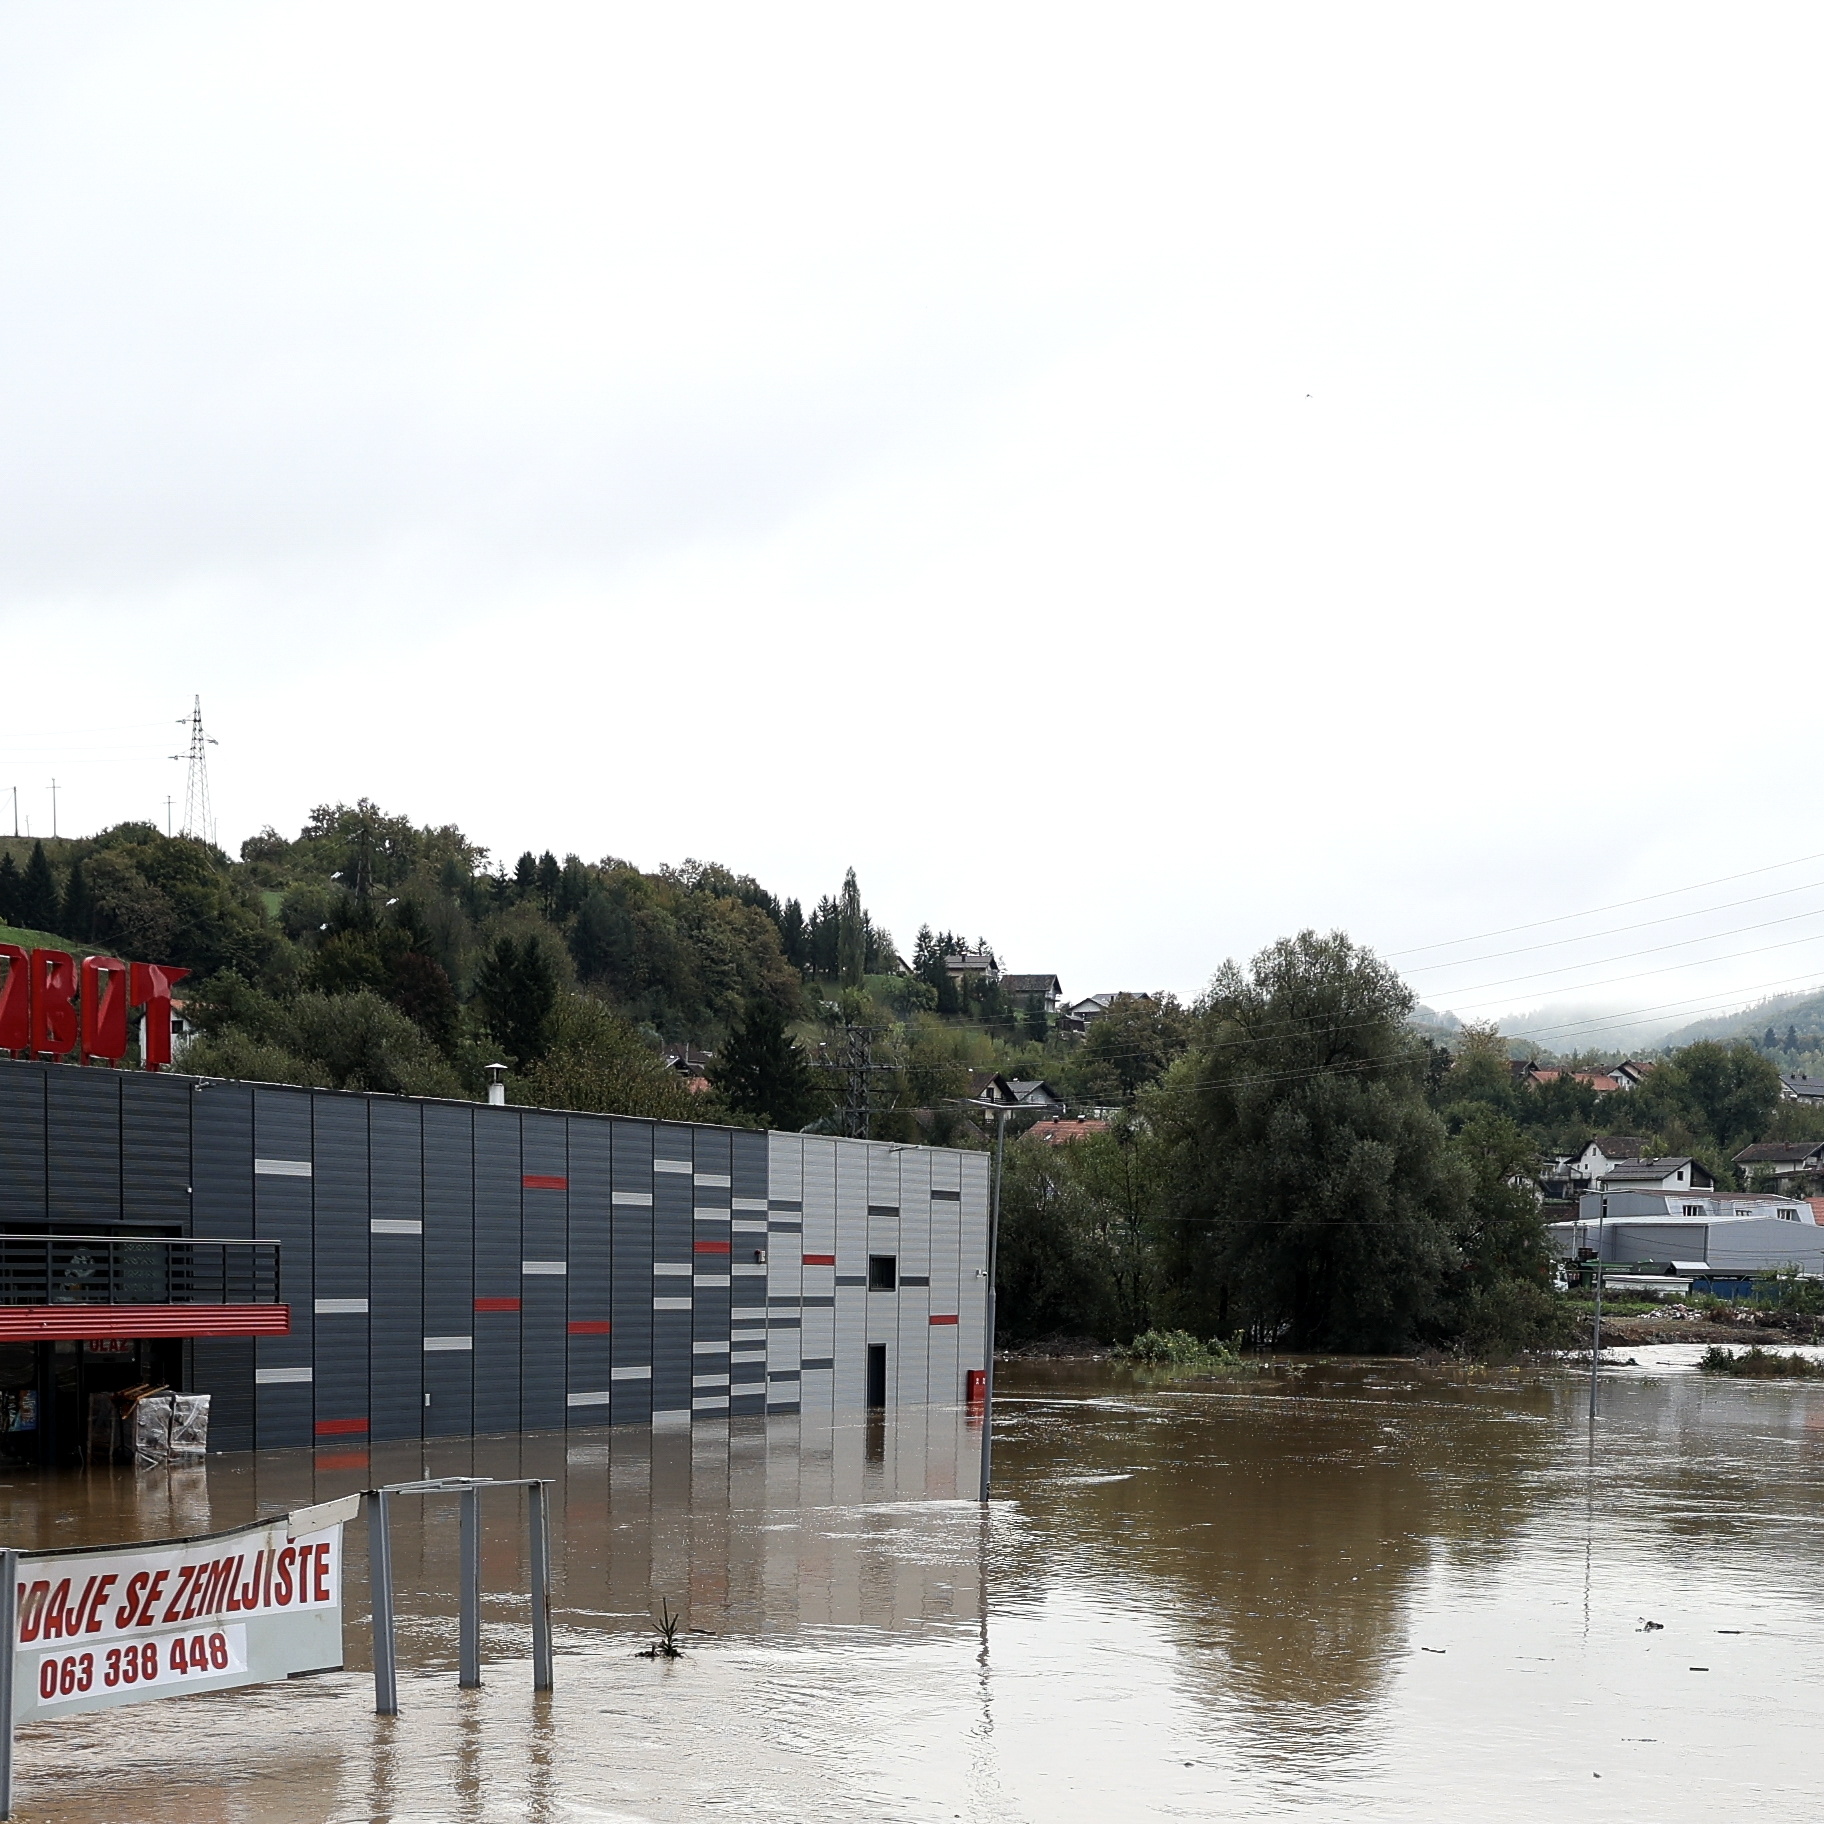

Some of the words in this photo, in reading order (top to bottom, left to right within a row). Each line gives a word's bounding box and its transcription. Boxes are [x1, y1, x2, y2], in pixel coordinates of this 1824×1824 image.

[115, 1569, 170, 1630] SE
[162, 1537, 331, 1624] ZEMLJIŠTE
[40, 1652, 94, 1700] 063
[104, 1641, 158, 1688] 338
[169, 1632, 229, 1676] 448
